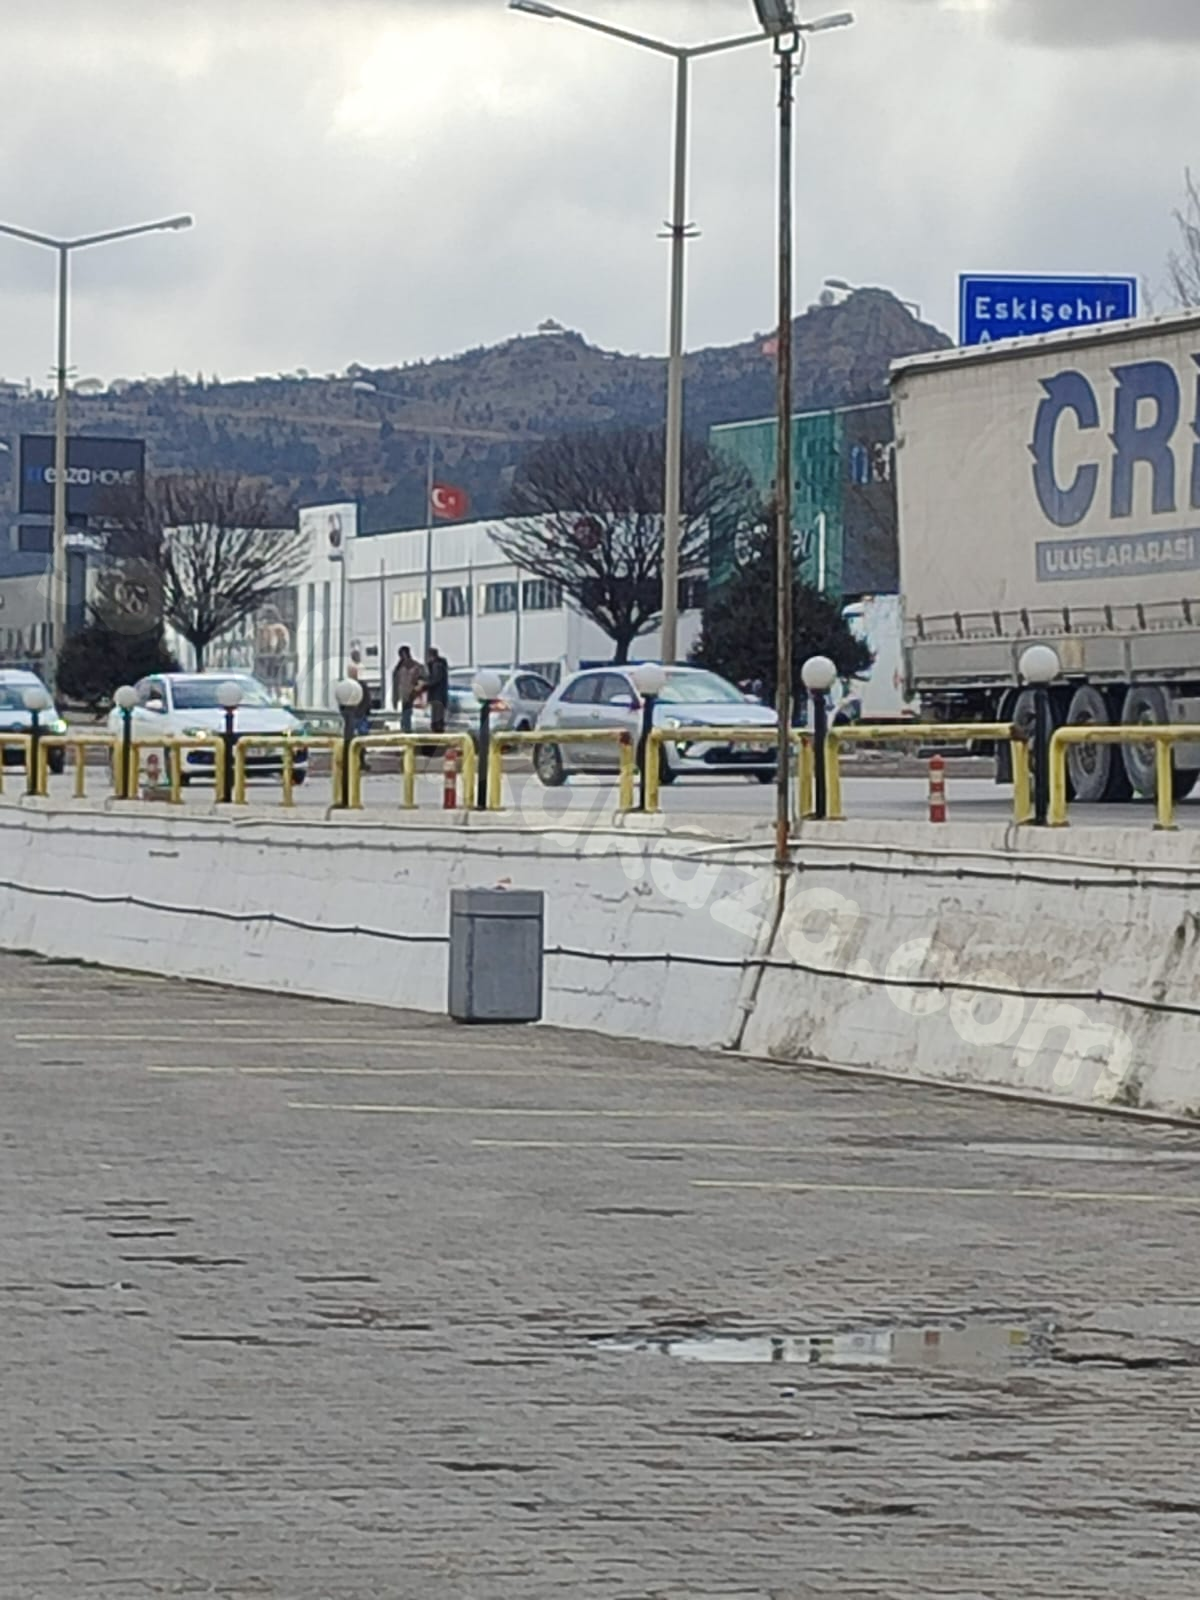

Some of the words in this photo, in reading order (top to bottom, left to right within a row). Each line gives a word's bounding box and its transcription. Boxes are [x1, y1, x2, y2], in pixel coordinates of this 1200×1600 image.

[974, 296, 1116, 322] Eskişehir
[1028, 354, 1200, 528] CR
[1046, 537, 1193, 571] ULUSLARARASI
